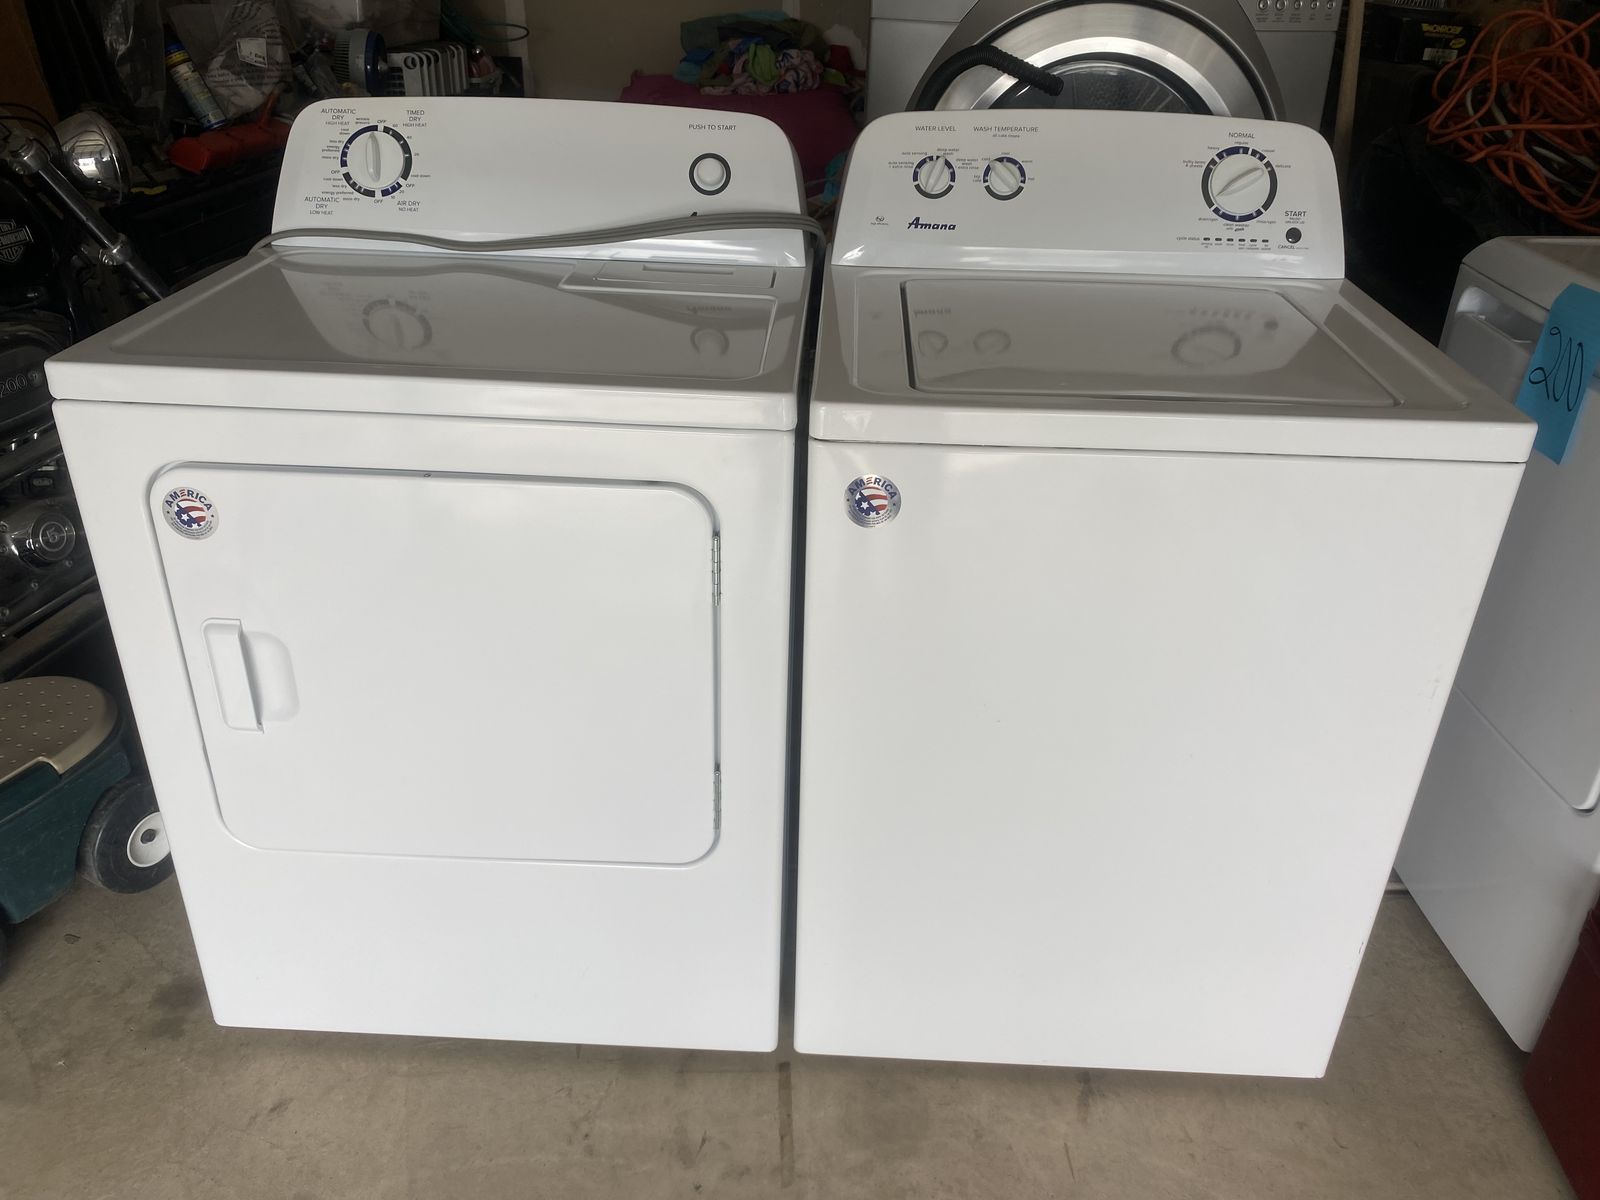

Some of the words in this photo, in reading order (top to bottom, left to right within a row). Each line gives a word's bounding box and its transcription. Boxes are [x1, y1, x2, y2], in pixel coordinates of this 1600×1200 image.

[1228, 131, 1255, 139] NORMAL
[907, 216, 957, 231] Amana
[1528, 326, 1585, 412] 200
[848, 476, 897, 500] AMERICA
[165, 489, 213, 511] AMERICA
